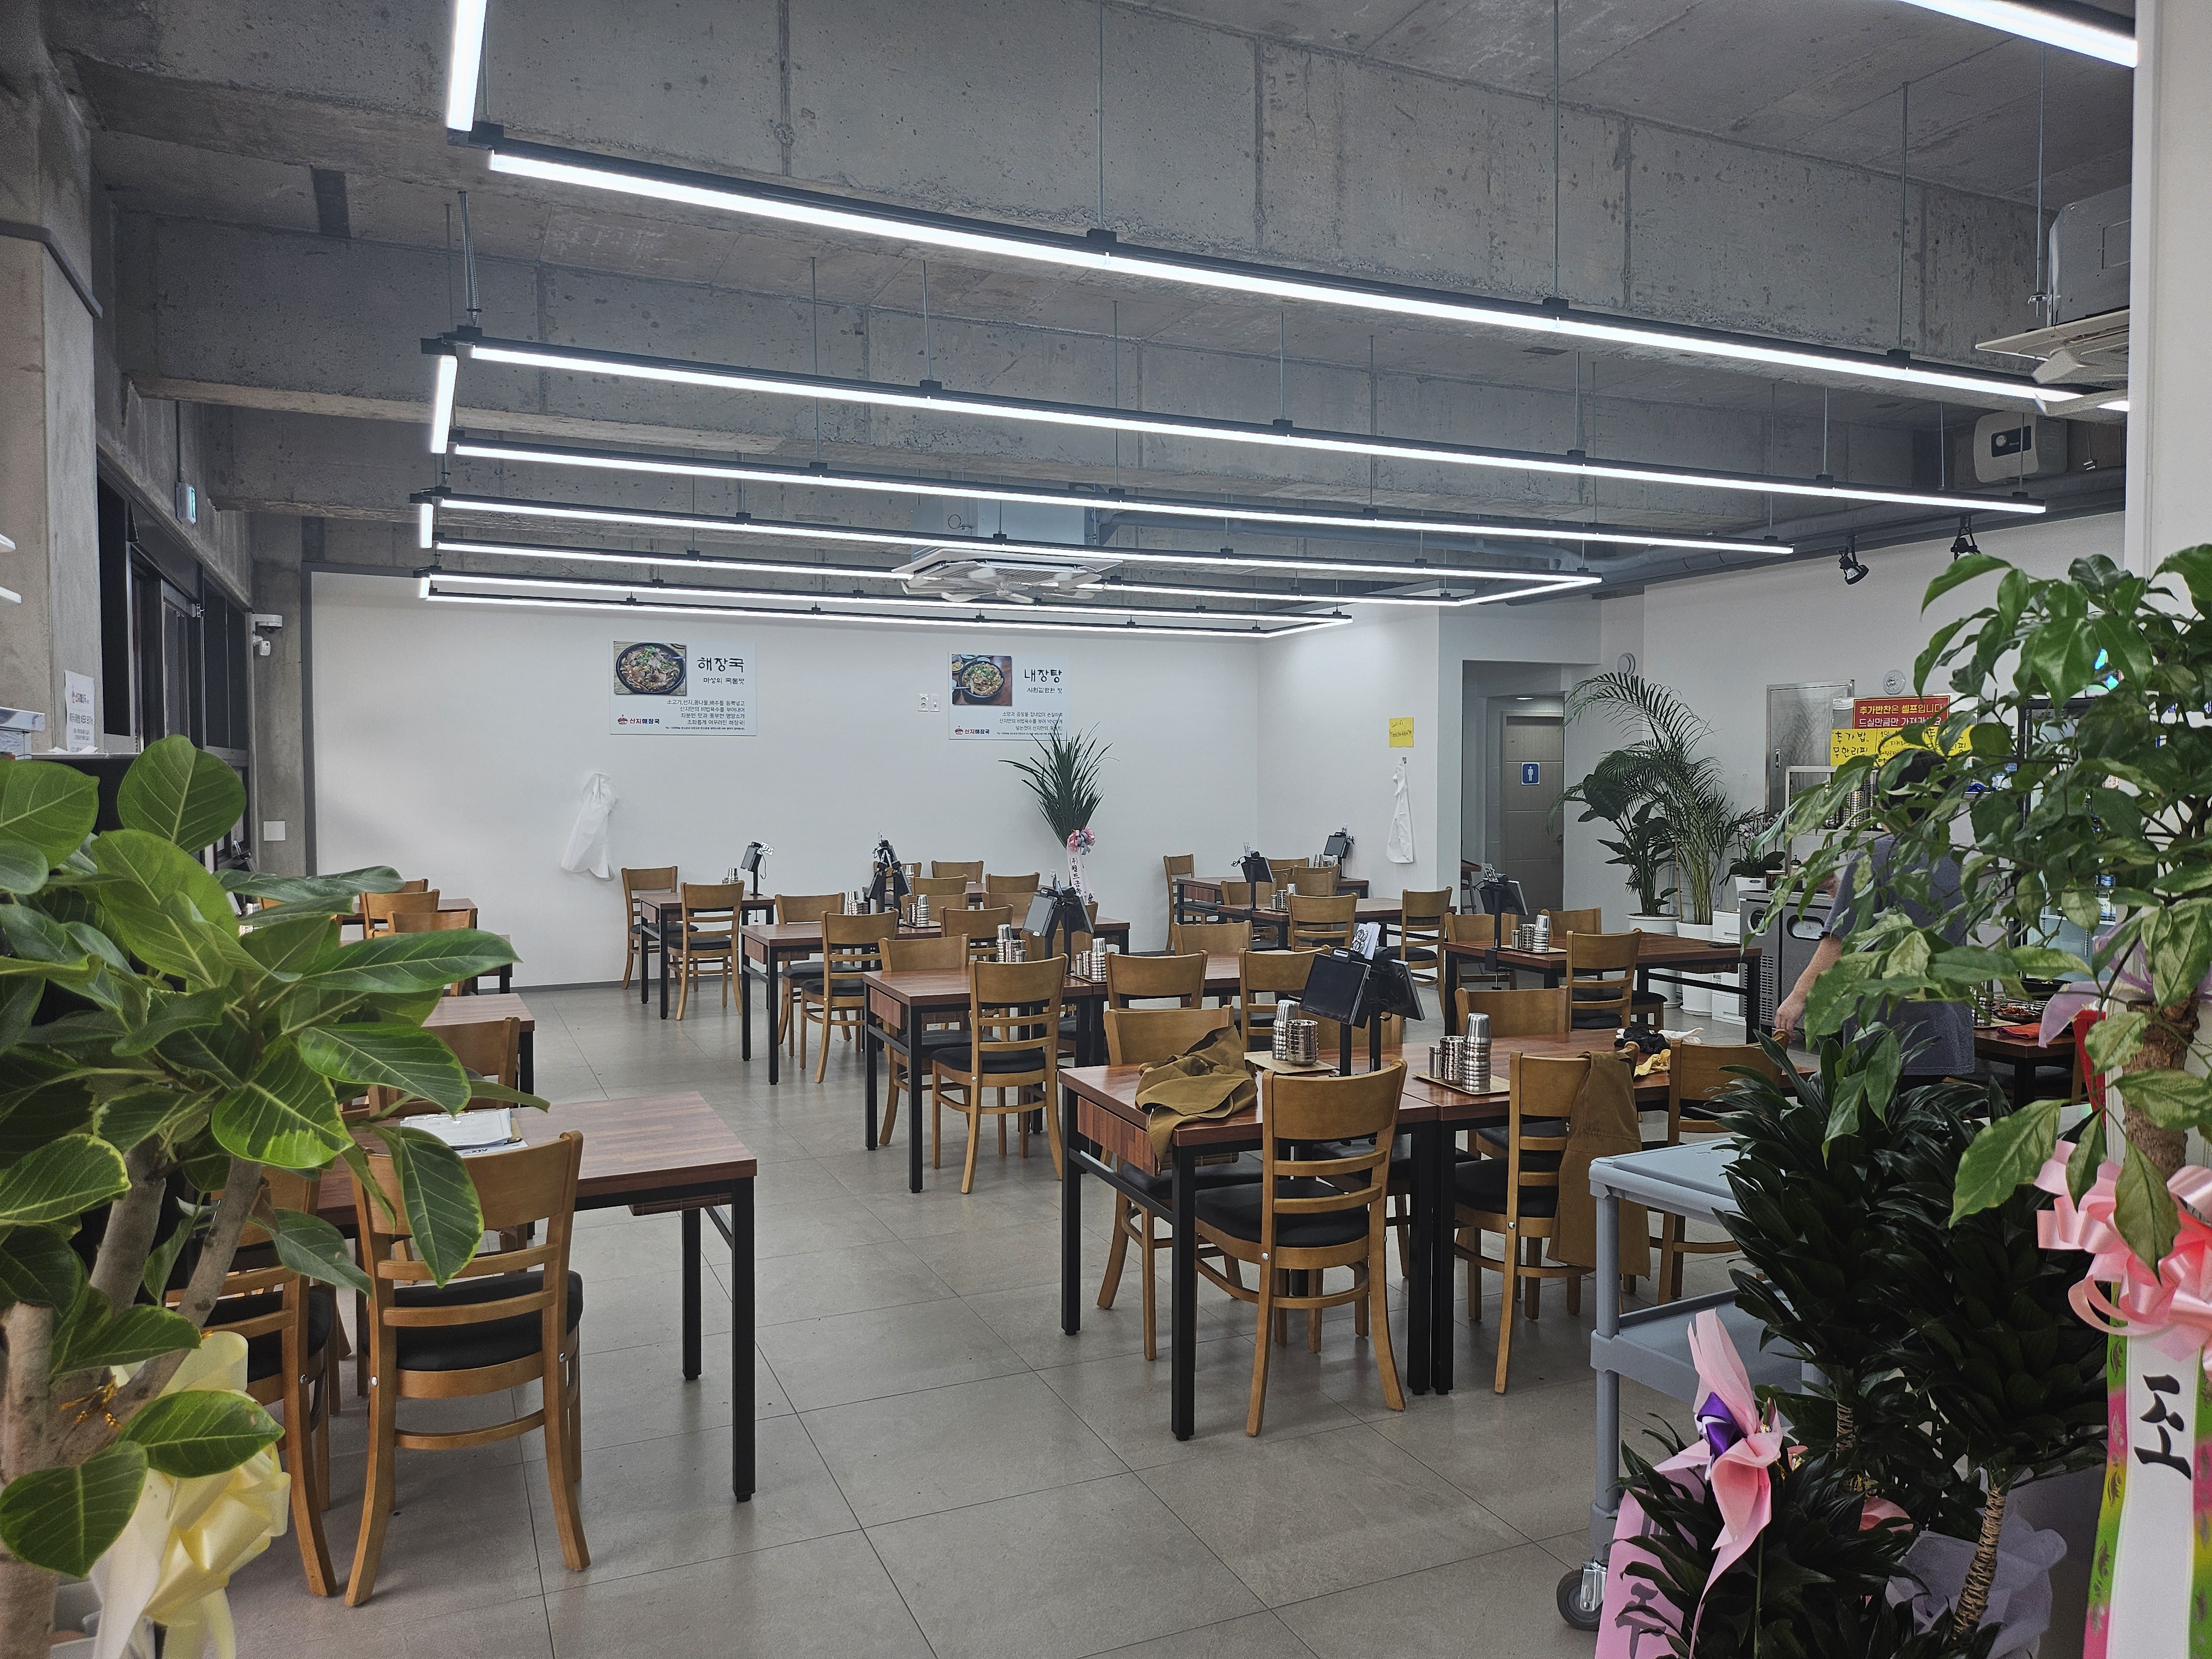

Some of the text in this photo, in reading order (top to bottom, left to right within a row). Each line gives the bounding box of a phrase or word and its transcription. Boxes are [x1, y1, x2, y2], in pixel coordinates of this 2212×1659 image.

[697, 657, 744, 672] 해장국
[1024, 669, 1062, 683] 내장탕
[1859, 703, 1943, 714] 추가반찬은 셀프입니다
[1859, 718, 1899, 727] 드실만큼만
[2134, 1374, 2192, 1480] 조
